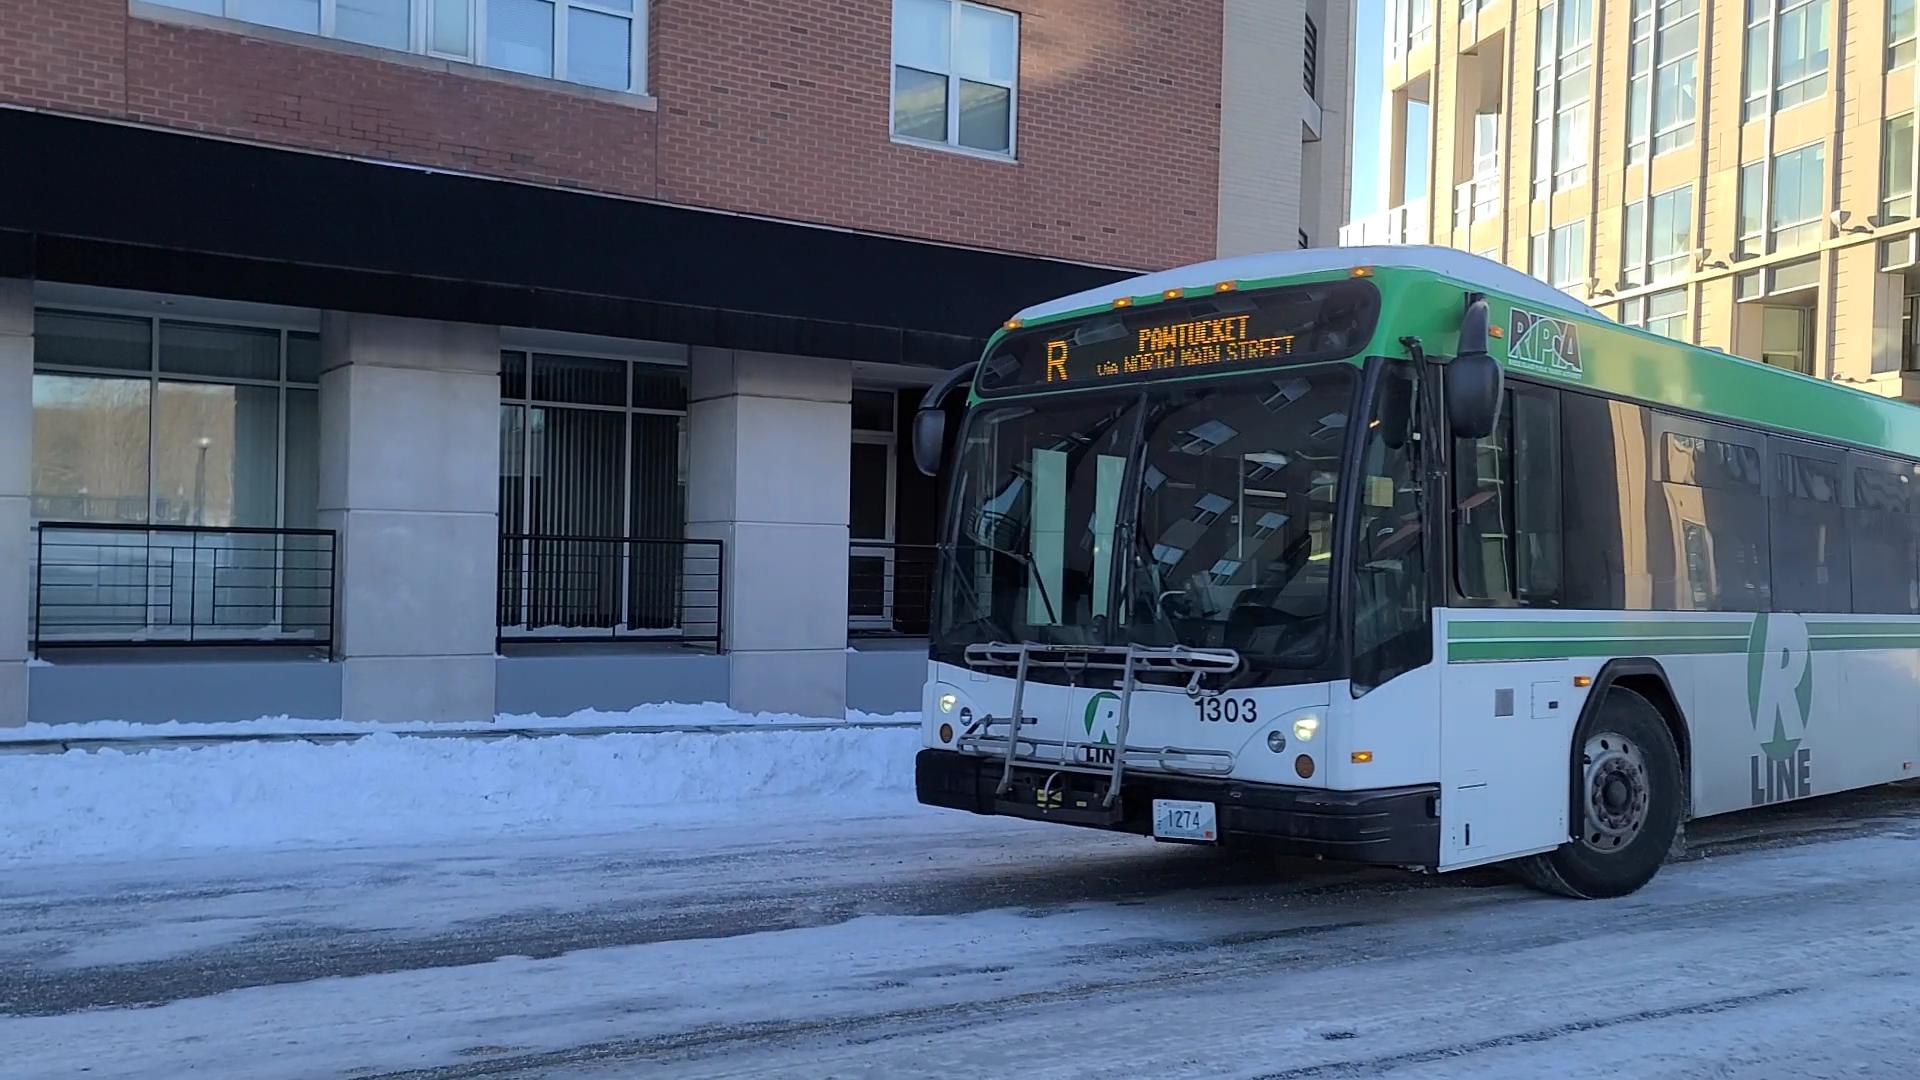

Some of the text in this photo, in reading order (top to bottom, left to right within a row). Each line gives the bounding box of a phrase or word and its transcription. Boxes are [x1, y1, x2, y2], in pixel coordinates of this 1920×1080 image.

[1138, 314, 1250, 352] PAWTUCKET
[1508, 307, 1583, 373] RIPA
[1047, 340, 1068, 382] R
[1096, 361, 1119, 376] via
[1123, 351, 1175, 373] NORTH
[1181, 345, 1220, 367] MAIN
[1755, 612, 1808, 743] R
[1195, 697, 1257, 723] 1303
[1086, 746, 1115, 764] LIN
[1751, 748, 1811, 805] LINE
[1168, 809, 1200, 830] 1274
